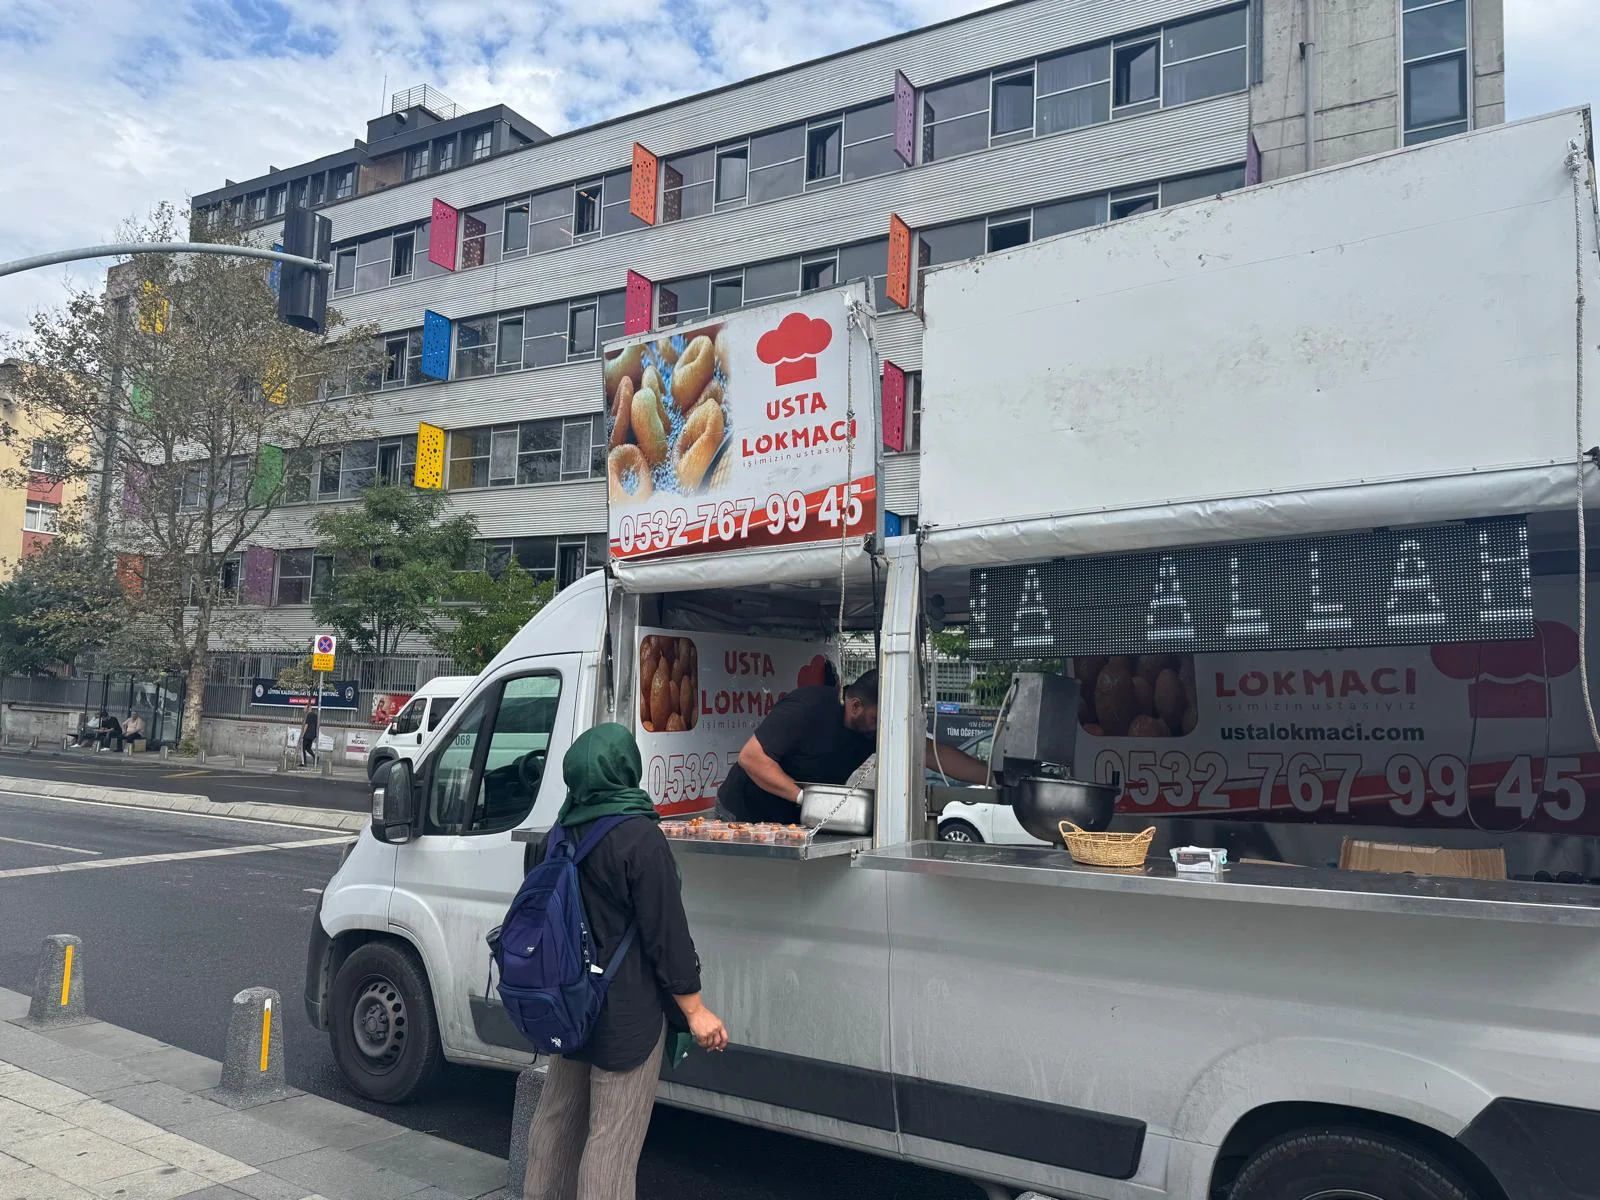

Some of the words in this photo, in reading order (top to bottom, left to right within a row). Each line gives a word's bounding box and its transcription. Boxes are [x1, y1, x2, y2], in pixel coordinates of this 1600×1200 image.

[766, 392, 827, 420] USTA
[742, 419, 857, 457] LOKMACI
[743, 454, 792, 468] işimizin
[795, 444, 856, 458] ustasıyz
[619, 507, 688, 553] 0532
[697, 497, 755, 543] 767
[766, 490, 807, 535] 99
[818, 484, 863, 527] 45
[1147, 526, 1533, 640] ALLAH
[725, 651, 775, 677] USTA
[1215, 668, 1417, 698] LOKMACI
[1218, 702, 1304, 713] işimizin
[1312, 701, 1416, 712] ustasıyız
[702, 719, 747, 731] işimizin
[1220, 723, 1425, 741] ustalokmaci.com
[648, 752, 718, 806] 0532
[1094, 749, 1231, 808] 0532
[1248, 752, 1363, 813] 767
[1385, 753, 1467, 817] 99
[1494, 754, 1586, 821] 45
